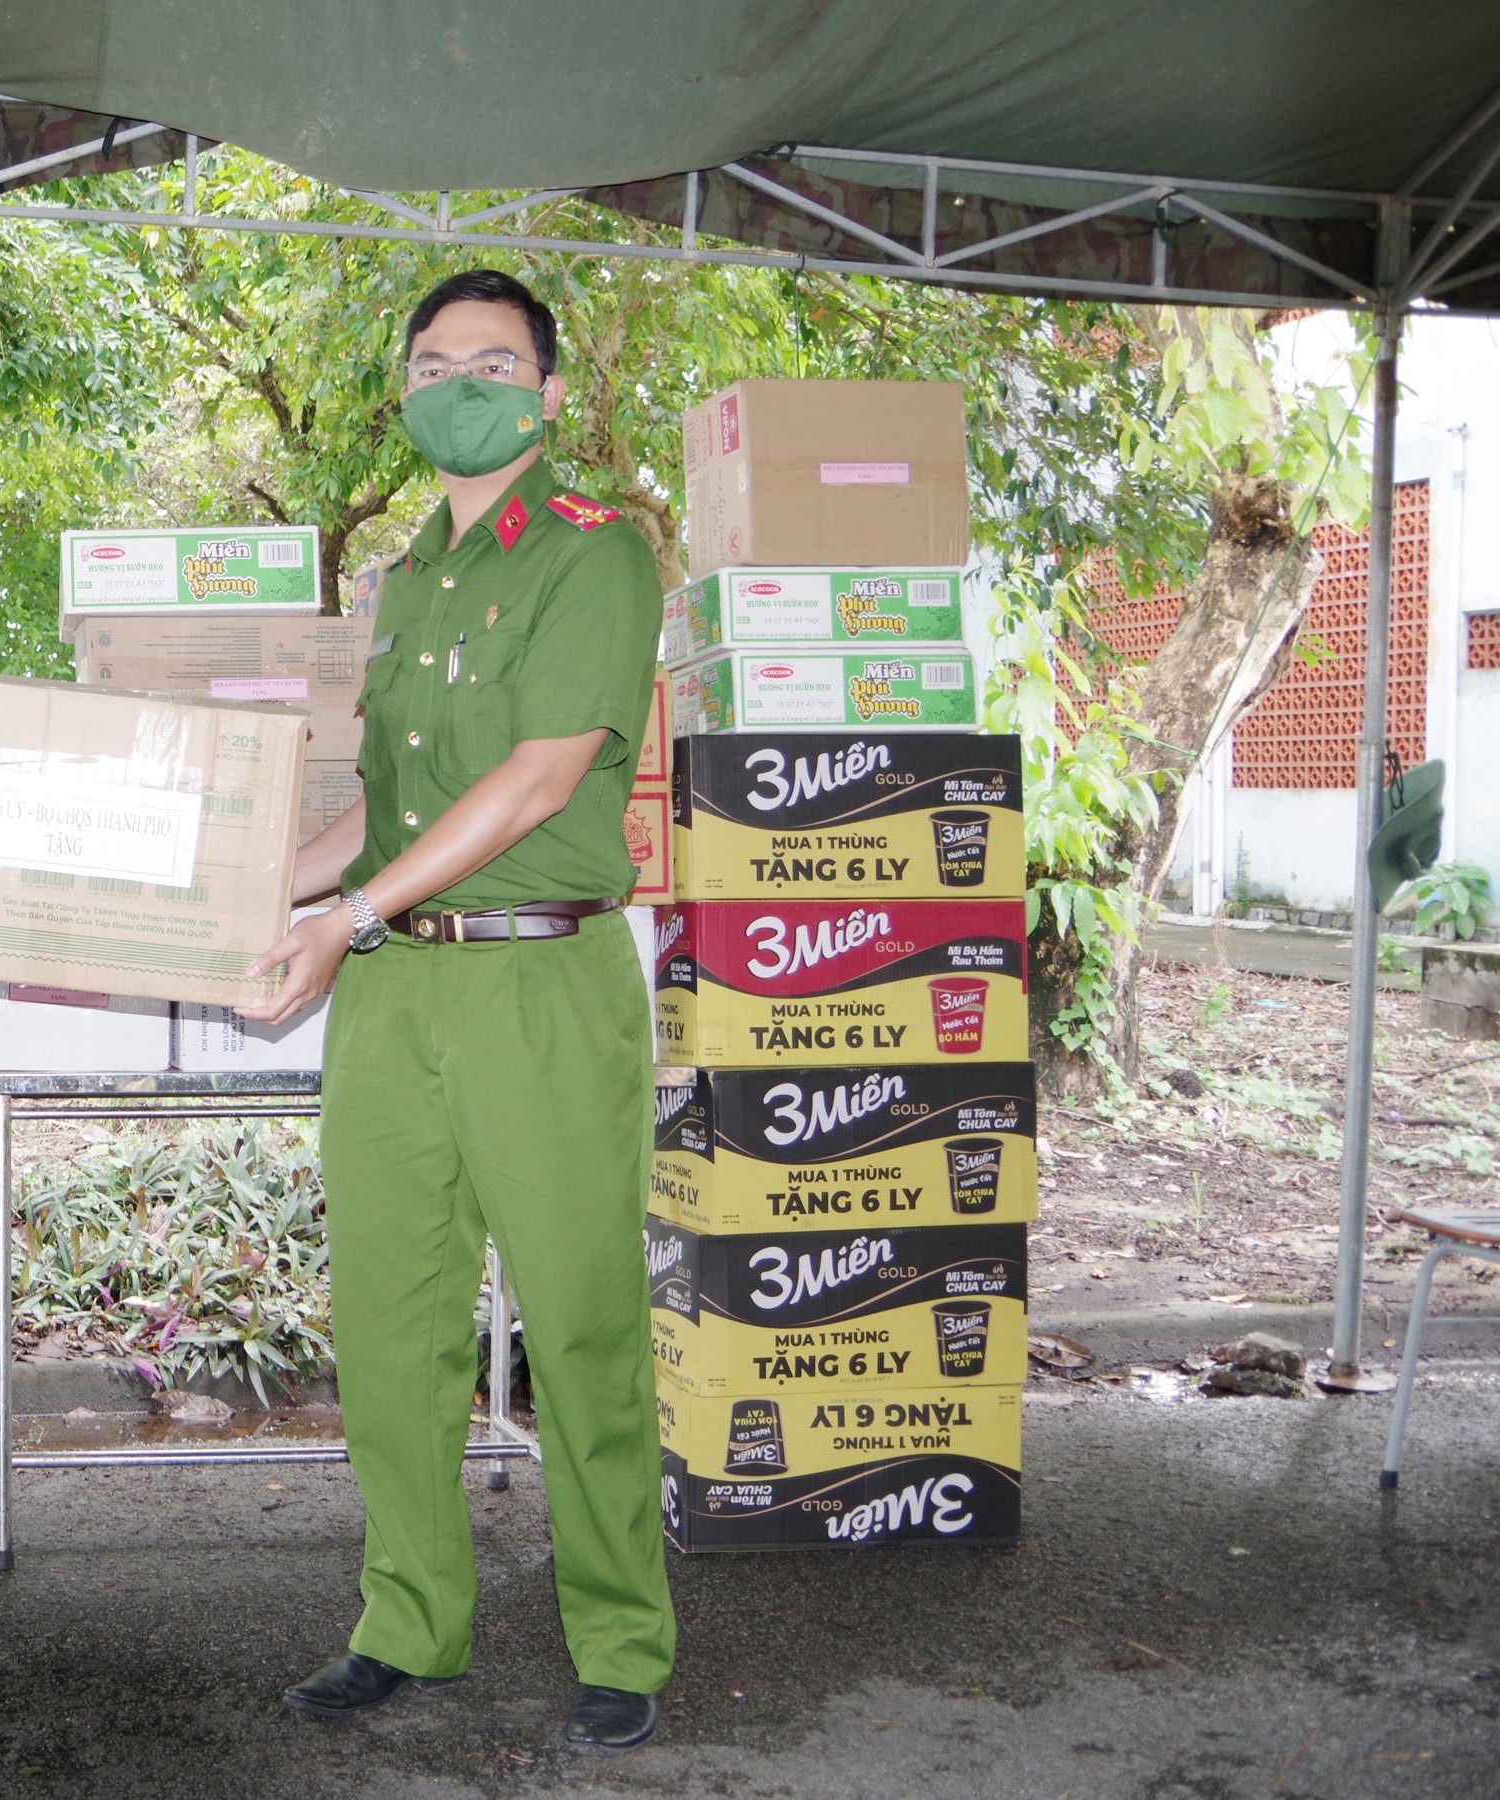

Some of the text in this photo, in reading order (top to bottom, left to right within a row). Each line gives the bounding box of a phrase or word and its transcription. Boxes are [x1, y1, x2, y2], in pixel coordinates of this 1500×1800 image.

[722, 405, 730, 450] VIFON
[231, 735, 262, 749] 20%
[875, 773, 915, 785] GOLD
[944, 780, 983, 790] Mì Tôm
[944, 790, 1006, 801] CHUA CAY
[772, 833, 887, 849] MUA 1 THÙNG
[750, 852, 836, 888] TẶNG
[847, 859, 865, 881] 6
[875, 858, 909, 881] LY
[5, 909, 26, 919] Theo
[136, 923, 165, 934] ORION
[93, 907, 118, 917] TNHH
[168, 915, 197, 926] ORION
[198, 918, 220, 929] VINA
[875, 942, 914, 953] GOLD
[948, 945, 1003, 956] Mì Bò Hầm
[952, 955, 1003, 966] Rau Thơm
[772, 1000, 885, 1017] MUA 1 THÙNG
[750, 1019, 906, 1057] TẶNG 6 LY
[890, 1104, 929, 1116] GOLD
[958, 1109, 996, 1119] Mì Tôm
[958, 1118, 1018, 1130] CHUA CAY
[788, 1164, 902, 1184] MUA 1 THÙNG
[679, 1185, 685, 1200] 6
[687, 1188, 699, 1207] LY
[766, 1186, 923, 1222] TẶNG 6 LY
[878, 1266, 917, 1279] GOLD
[946, 1271, 985, 1282] Mì Tôm
[946, 1281, 1006, 1293] CHUA CAY
[775, 1327, 890, 1347] MUA 1 THÙNG
[753, 1350, 911, 1385] TẶNG 6 LY
[810, 1397, 972, 1432] TẶNG 6 LY
[833, 1435, 950, 1453] MUA 1 THÙNG
[706, 1485, 772, 1496] CHUA CAY
[730, 1495, 758, 1505] Tôm
[802, 1500, 843, 1511] GOLD
